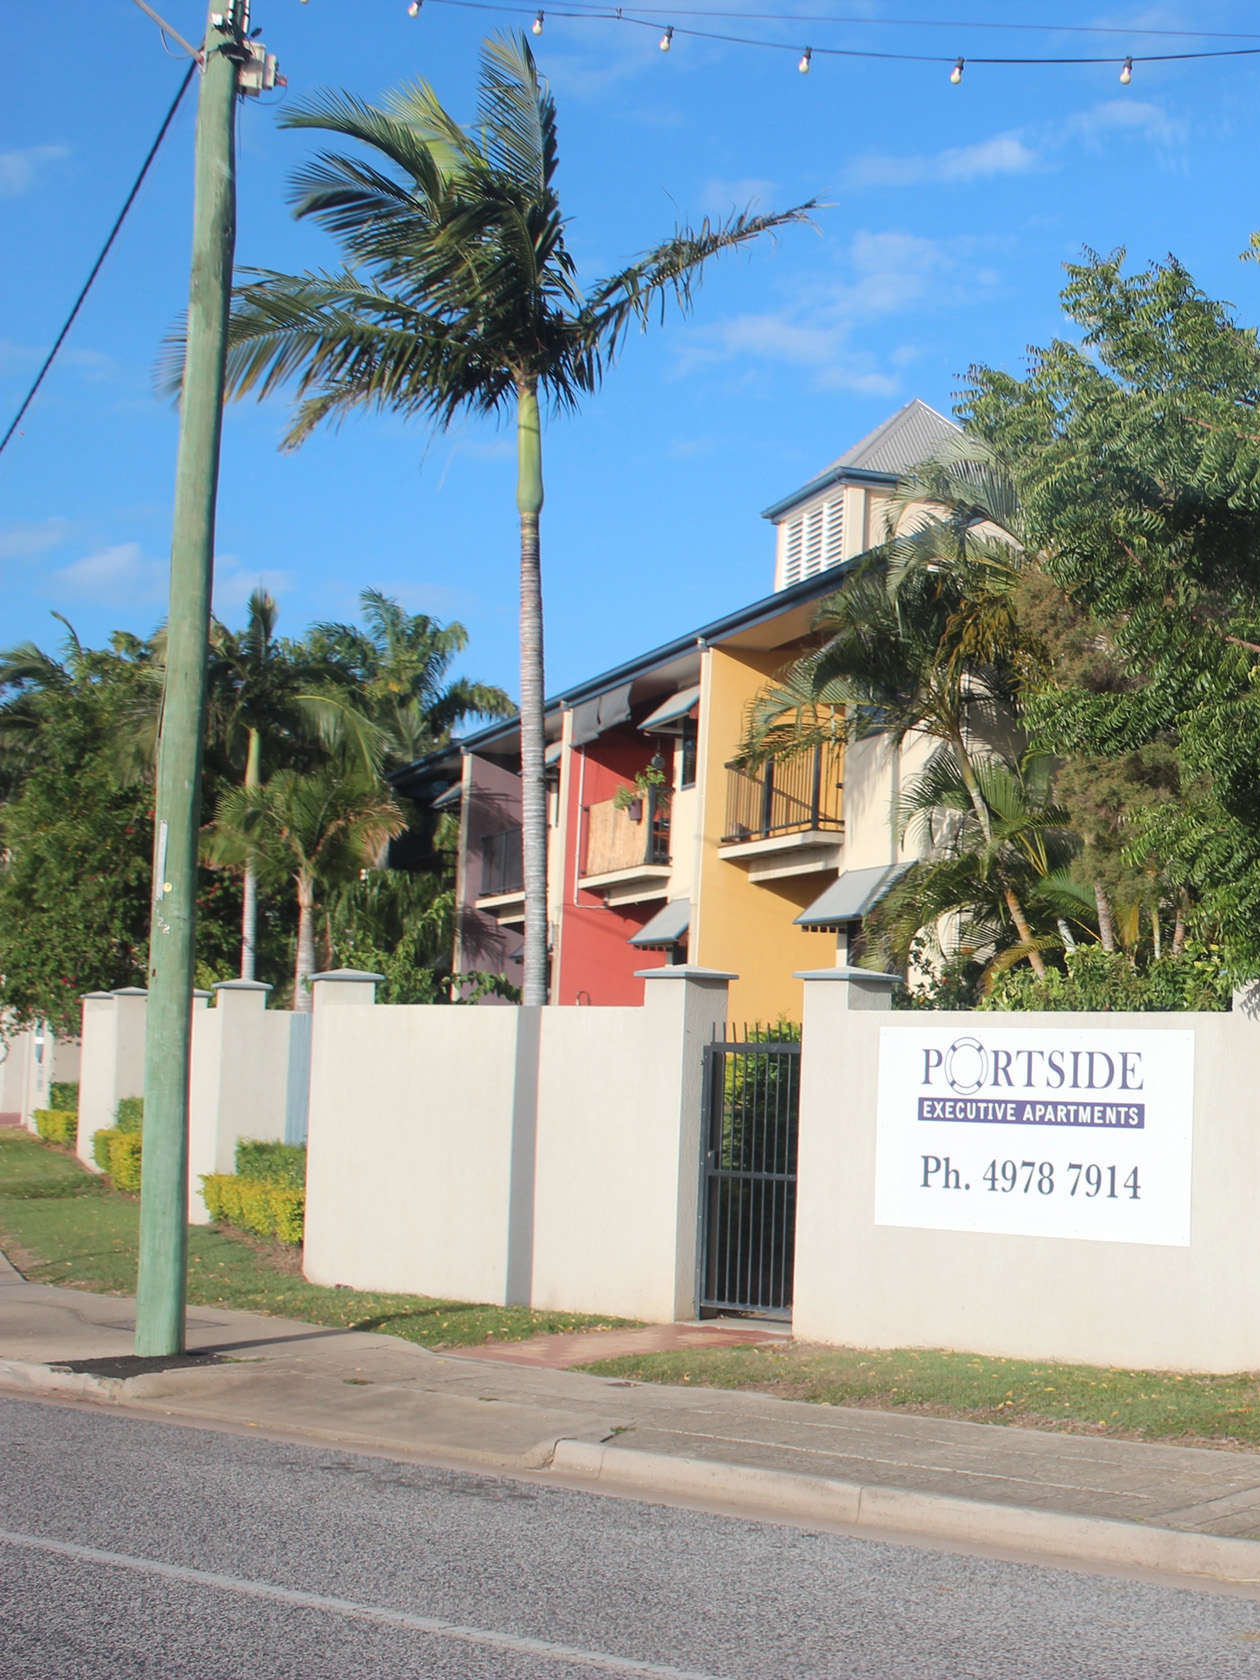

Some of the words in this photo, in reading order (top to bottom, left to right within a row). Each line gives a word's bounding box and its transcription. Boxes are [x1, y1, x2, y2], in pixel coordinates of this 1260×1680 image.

[920, 1036, 1145, 1096] PORTSIDE
[922, 1100, 1017, 1121] EXECUTIVE
[1022, 1103, 1140, 1126] APARTMENTS
[920, 1155, 971, 1191] Ph.
[982, 1159, 1055, 1195] 4978
[1066, 1162, 1142, 1200] 7914
